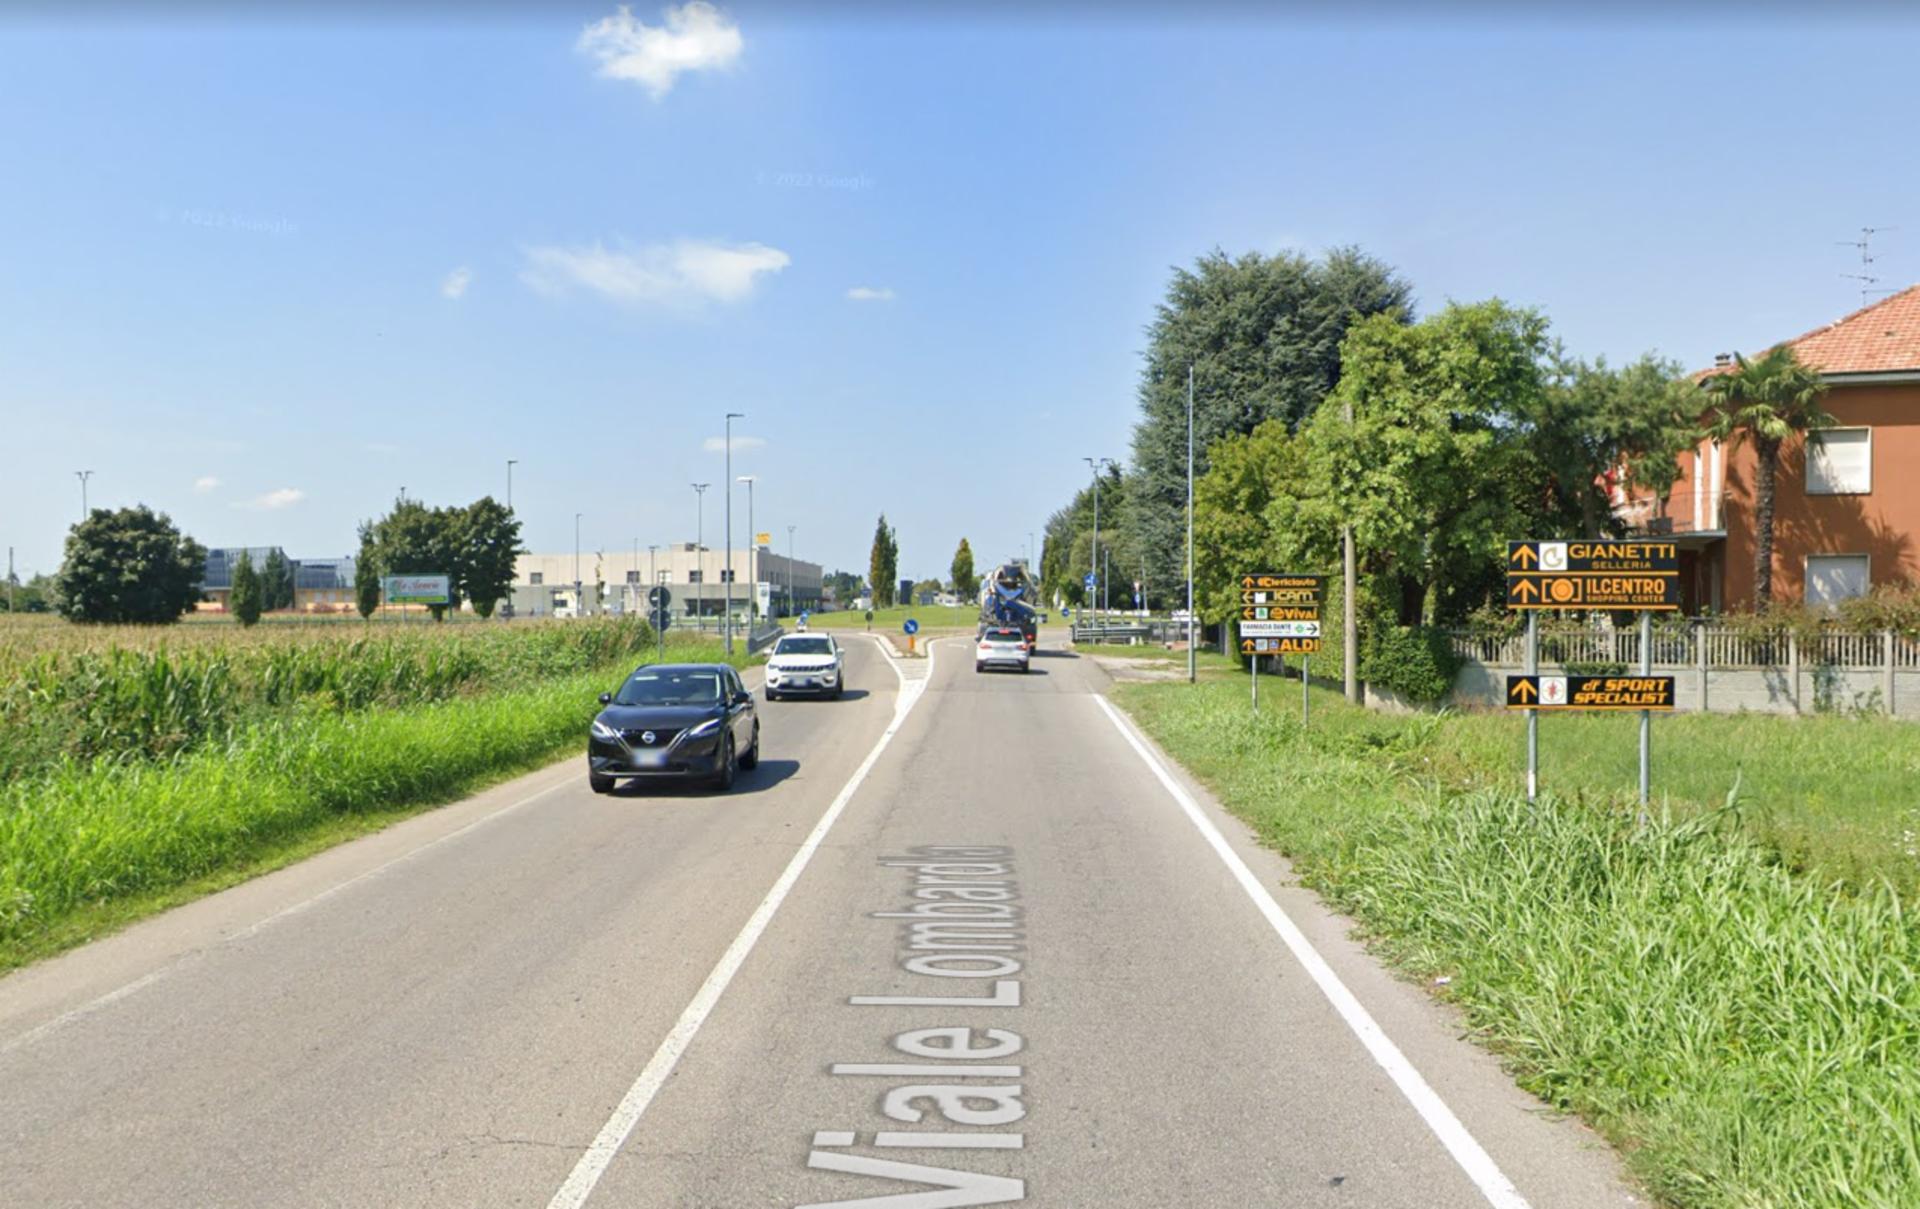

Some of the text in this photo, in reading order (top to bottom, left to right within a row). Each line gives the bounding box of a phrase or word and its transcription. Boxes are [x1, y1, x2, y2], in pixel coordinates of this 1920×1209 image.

[1568, 543, 1676, 559] GIANETTI
[1591, 560, 1651, 569] SELLERIA
[1586, 578, 1666, 594] ILCENTRO
[1587, 595, 1665, 603] SHOPPING CENTER
[1280, 639, 1320, 651] ALDI
[1605, 679, 1669, 691] SPORT
[1573, 692, 1668, 704] SPECIALIST
